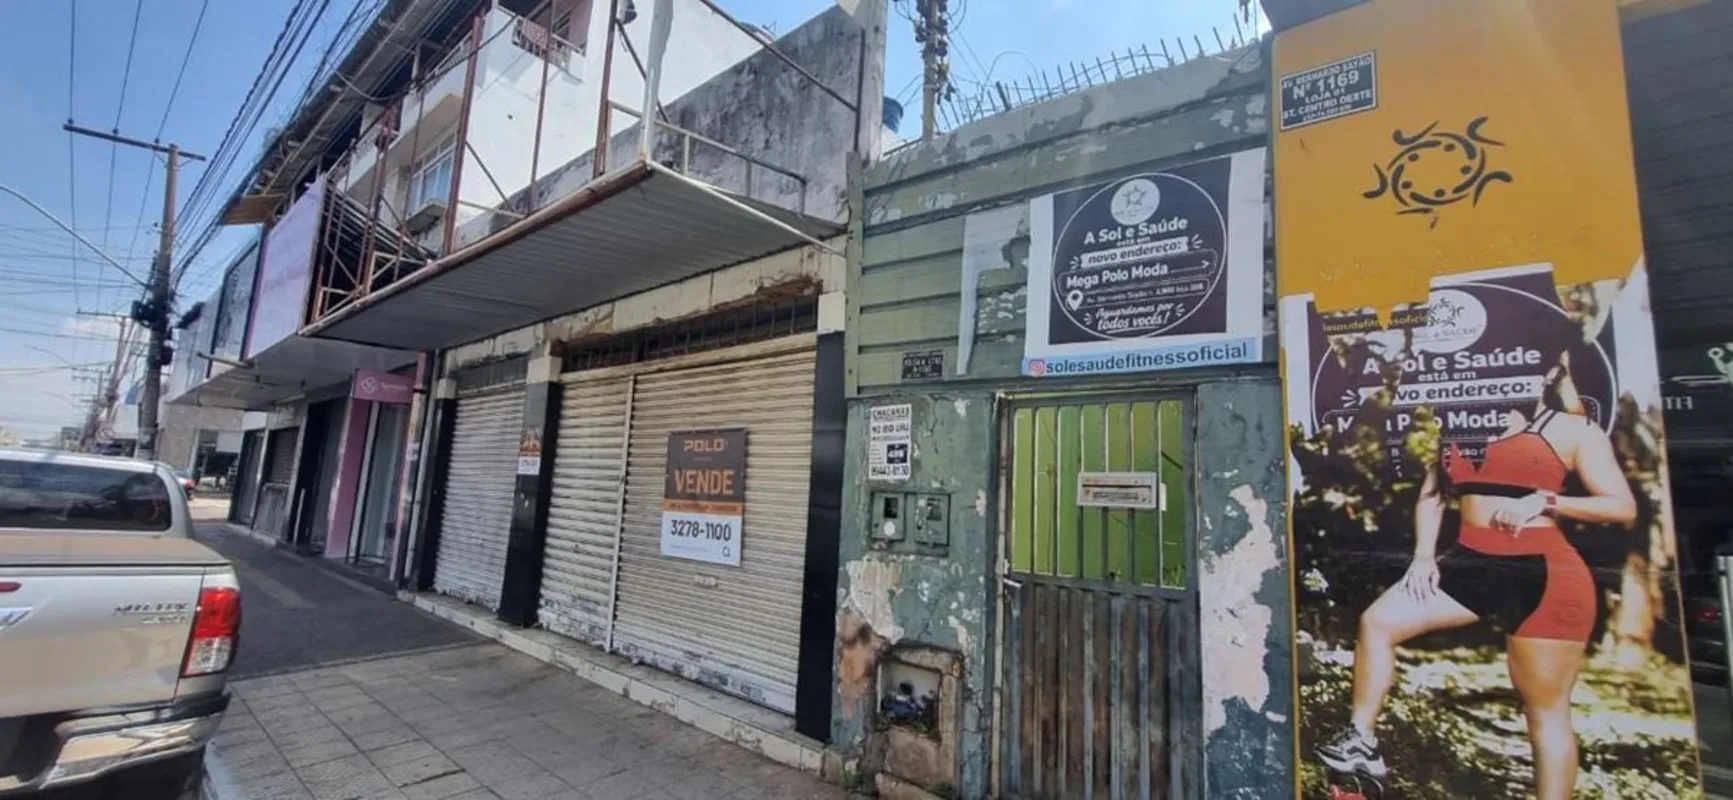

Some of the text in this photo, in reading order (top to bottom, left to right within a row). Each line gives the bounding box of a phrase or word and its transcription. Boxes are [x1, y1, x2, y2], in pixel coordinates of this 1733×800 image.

[1317, 70, 1359, 92] 1169
[1298, 99, 1337, 115] CENTRO
[1340, 89, 1372, 104] OESTE
[1305, 91, 1331, 104] LOJA
[1084, 216, 1188, 245] A Sol e Saúde
[1088, 240, 1182, 265] novo endereço:
[1066, 262, 1168, 289] Mega Polo Moda
[1096, 303, 1174, 321] Aguardamos por
[1097, 312, 1171, 331] todos vocês!
[1046, 342, 1247, 373] solesaudefitnessoficial
[1362, 346, 1542, 375] A ol e Saúde
[1418, 369, 1477, 382] está em
[1426, 381, 1532, 400] endereço:
[1447, 409, 1509, 428] Moda
[683, 438, 724, 453] POLO
[674, 469, 735, 495] VENDE
[671, 519, 732, 541] 3278-1100
